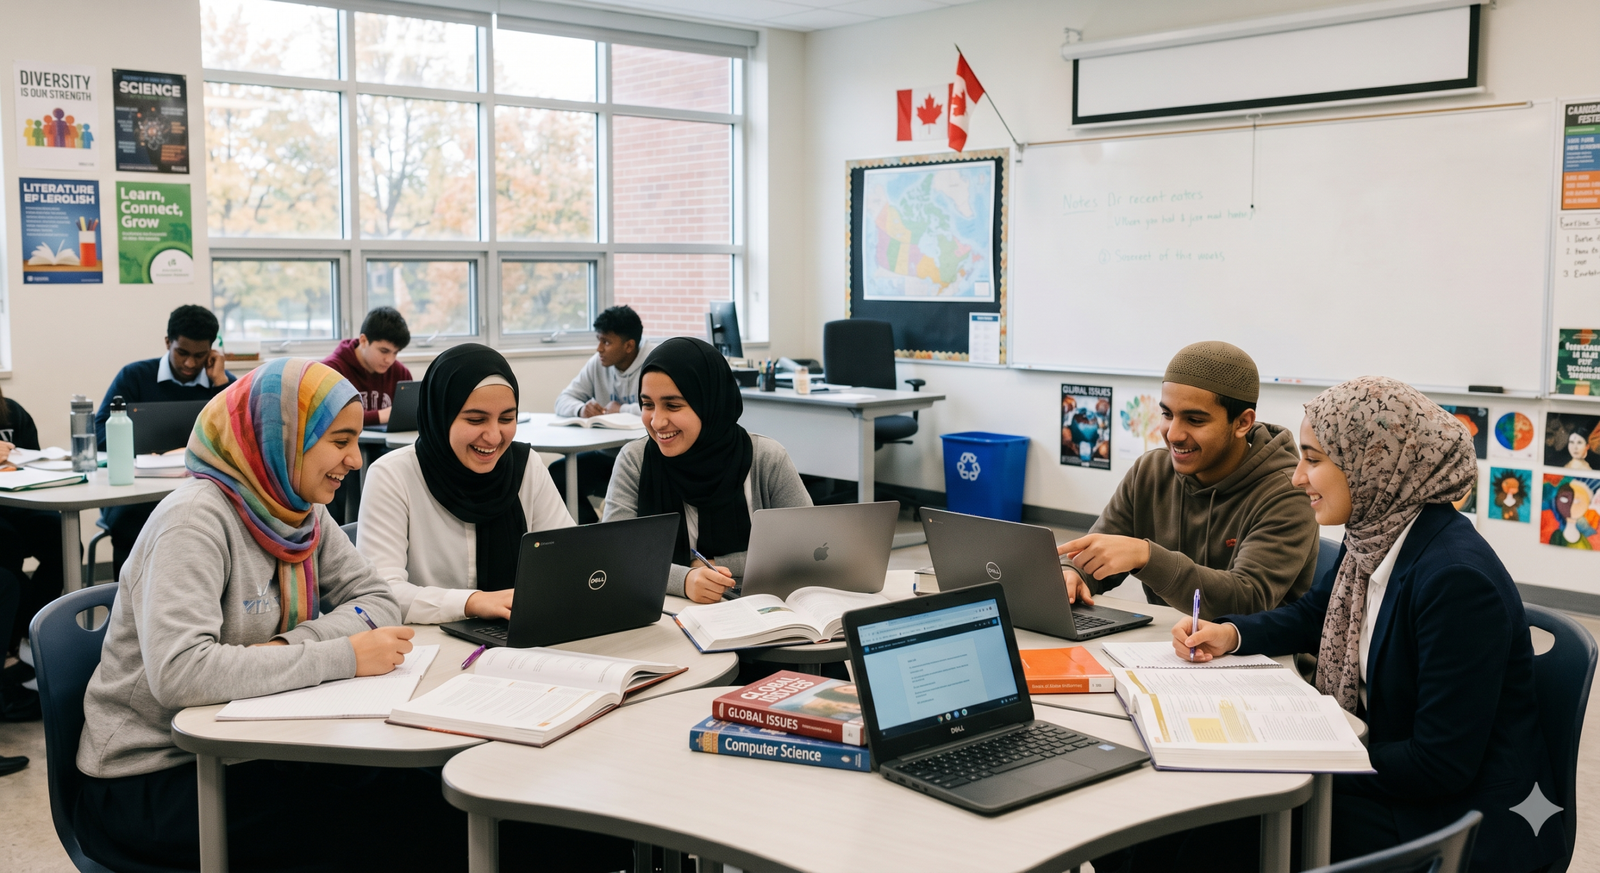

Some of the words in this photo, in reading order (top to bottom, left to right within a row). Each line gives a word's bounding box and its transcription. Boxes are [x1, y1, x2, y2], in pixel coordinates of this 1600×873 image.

[20, 70, 91, 90] DIVERSITY
[20, 87, 29, 97] IS
[49, 89, 92, 101] STRENGTH
[119, 81, 181, 97] SCIENCE
[23, 183, 95, 194] LITERATURE
[120, 187, 165, 203] Learn,
[120, 201, 183, 217] Connect,
[1063, 194, 1098, 210] Notes
[121, 215, 159, 228] Grow
[1088, 387, 1112, 397] ISSUES
[740, 677, 801, 700] GLOBAL
[728, 706, 764, 724] GLOBAL
[766, 714, 799, 730] ISSUES
[950, 725, 965, 735] DELL
[724, 737, 779, 757] Computer
[780, 744, 822, 762] Science
